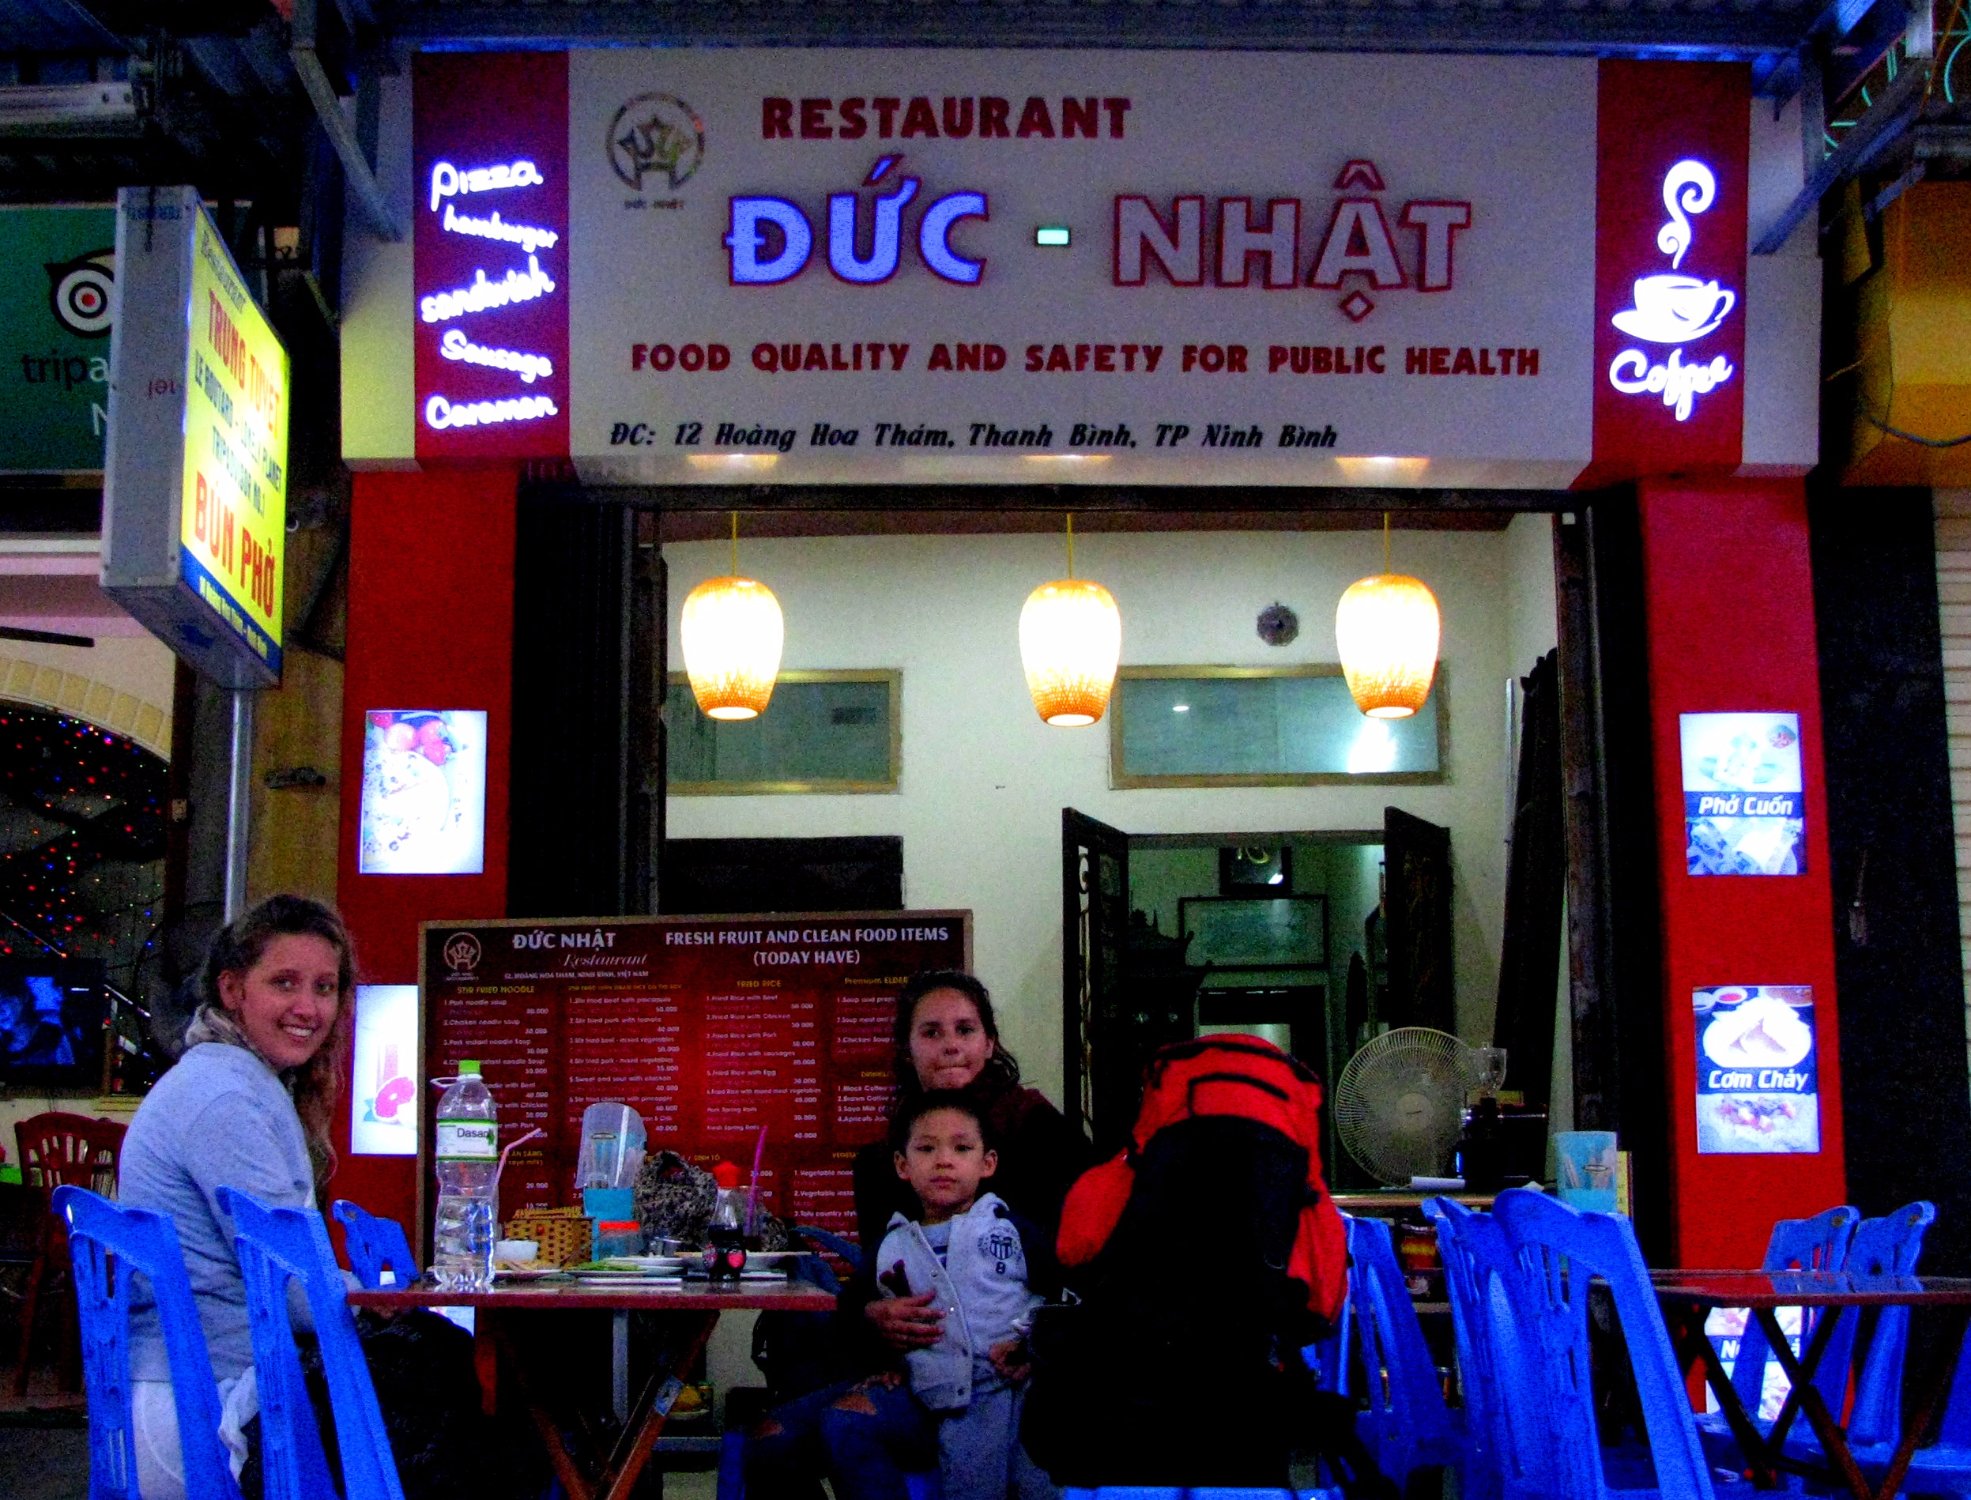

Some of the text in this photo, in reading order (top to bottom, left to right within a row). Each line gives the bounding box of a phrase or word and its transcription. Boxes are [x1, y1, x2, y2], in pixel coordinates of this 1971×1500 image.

[762, 97, 1131, 139] RESTAURANT
[430, 161, 543, 212] Pizza
[722, 154, 989, 287] ĐỨC
[1113, 158, 1471, 322] NHẬT
[208, 286, 246, 390] TRUNG
[632, 343, 1540, 376] FOOD QUALITY AND SAFETY FOR PUBLIC HEALTH
[611, 422, 1338, 452] ĐC: 12 Hoàng Hoa Thám, Thanh Bình, TP Ninh Bình
[239, 527, 276, 620] PHỞ
[1697, 794, 1794, 816] Phở Cuốn
[512, 929, 616, 952] ĐỨC NHẬT
[665, 927, 950, 946] FRESH FRUIT AND CLEAN FOOD ITEMS
[560, 953, 649, 969] Restaurant
[753, 949, 861, 967] (TODAY HAVE)
[1708, 1070, 1753, 1089] Cơm
